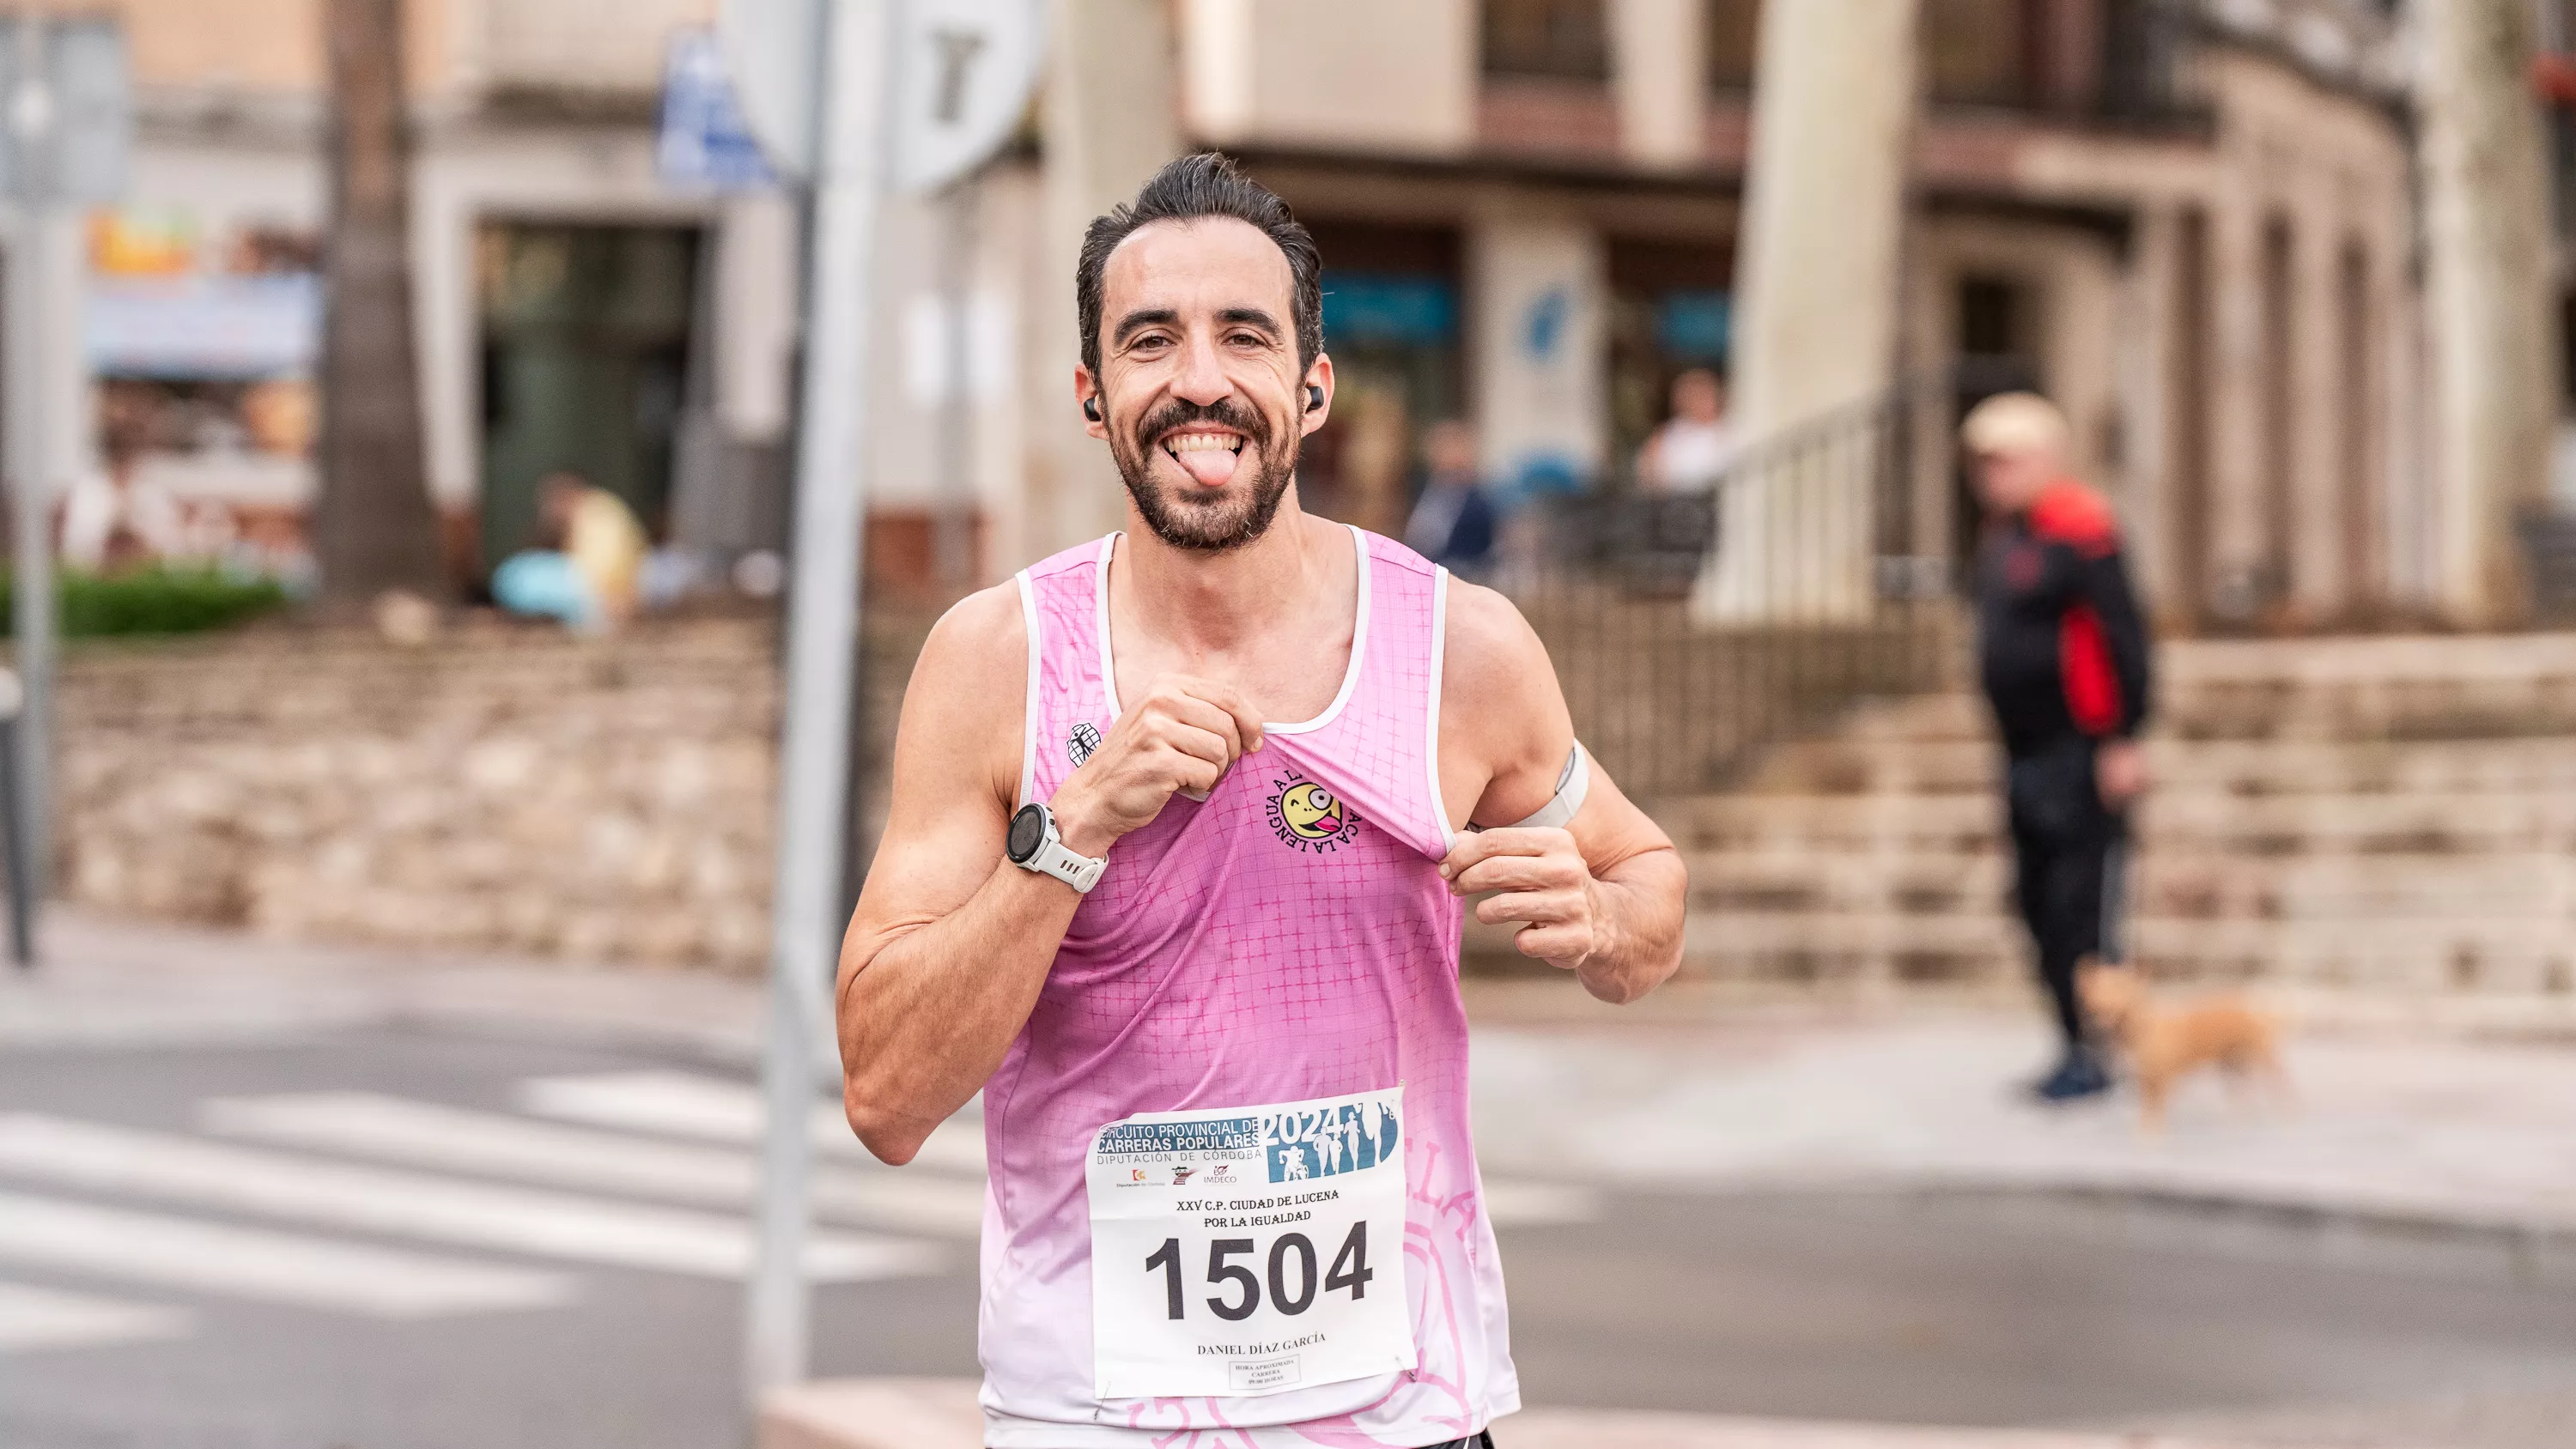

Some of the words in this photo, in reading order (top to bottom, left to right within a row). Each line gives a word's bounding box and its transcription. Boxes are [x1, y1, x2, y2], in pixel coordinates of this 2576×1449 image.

[1273, 779, 1287, 791] A
[1267, 795, 1309, 852] LENGUA
[1336, 809, 1362, 845] ACA
[1313, 840, 1336, 853] LA
[1159, 1120, 1238, 1138] PROVINCIAL
[1242, 1119, 1258, 1132] DE
[1261, 1108, 1344, 1147] 2024
[1097, 1137, 1171, 1153] CARRERAS
[1176, 1133, 1260, 1150] POPULARES
[1097, 1152, 1171, 1165] DIPUTACIÓN
[1181, 1152, 1195, 1161] DE
[1204, 1149, 1262, 1161] CÓRDOBA
[1176, 1199, 1202, 1211] XXV
[1205, 1201, 1226, 1211] C.P.
[1230, 1198, 1274, 1210] CIUDAD
[1278, 1196, 1291, 1207] DE
[1295, 1190, 1340, 1204] LUCENA
[1204, 1217, 1227, 1228] POR
[1230, 1216, 1247, 1228] LA
[1251, 1210, 1311, 1227] IGUALDAD
[1145, 1221, 1373, 1321] 1504
[1198, 1344, 1245, 1355] DANIEL
[1249, 1342, 1279, 1355] DÍAZ
[1283, 1331, 1326, 1350] GARCÍA
